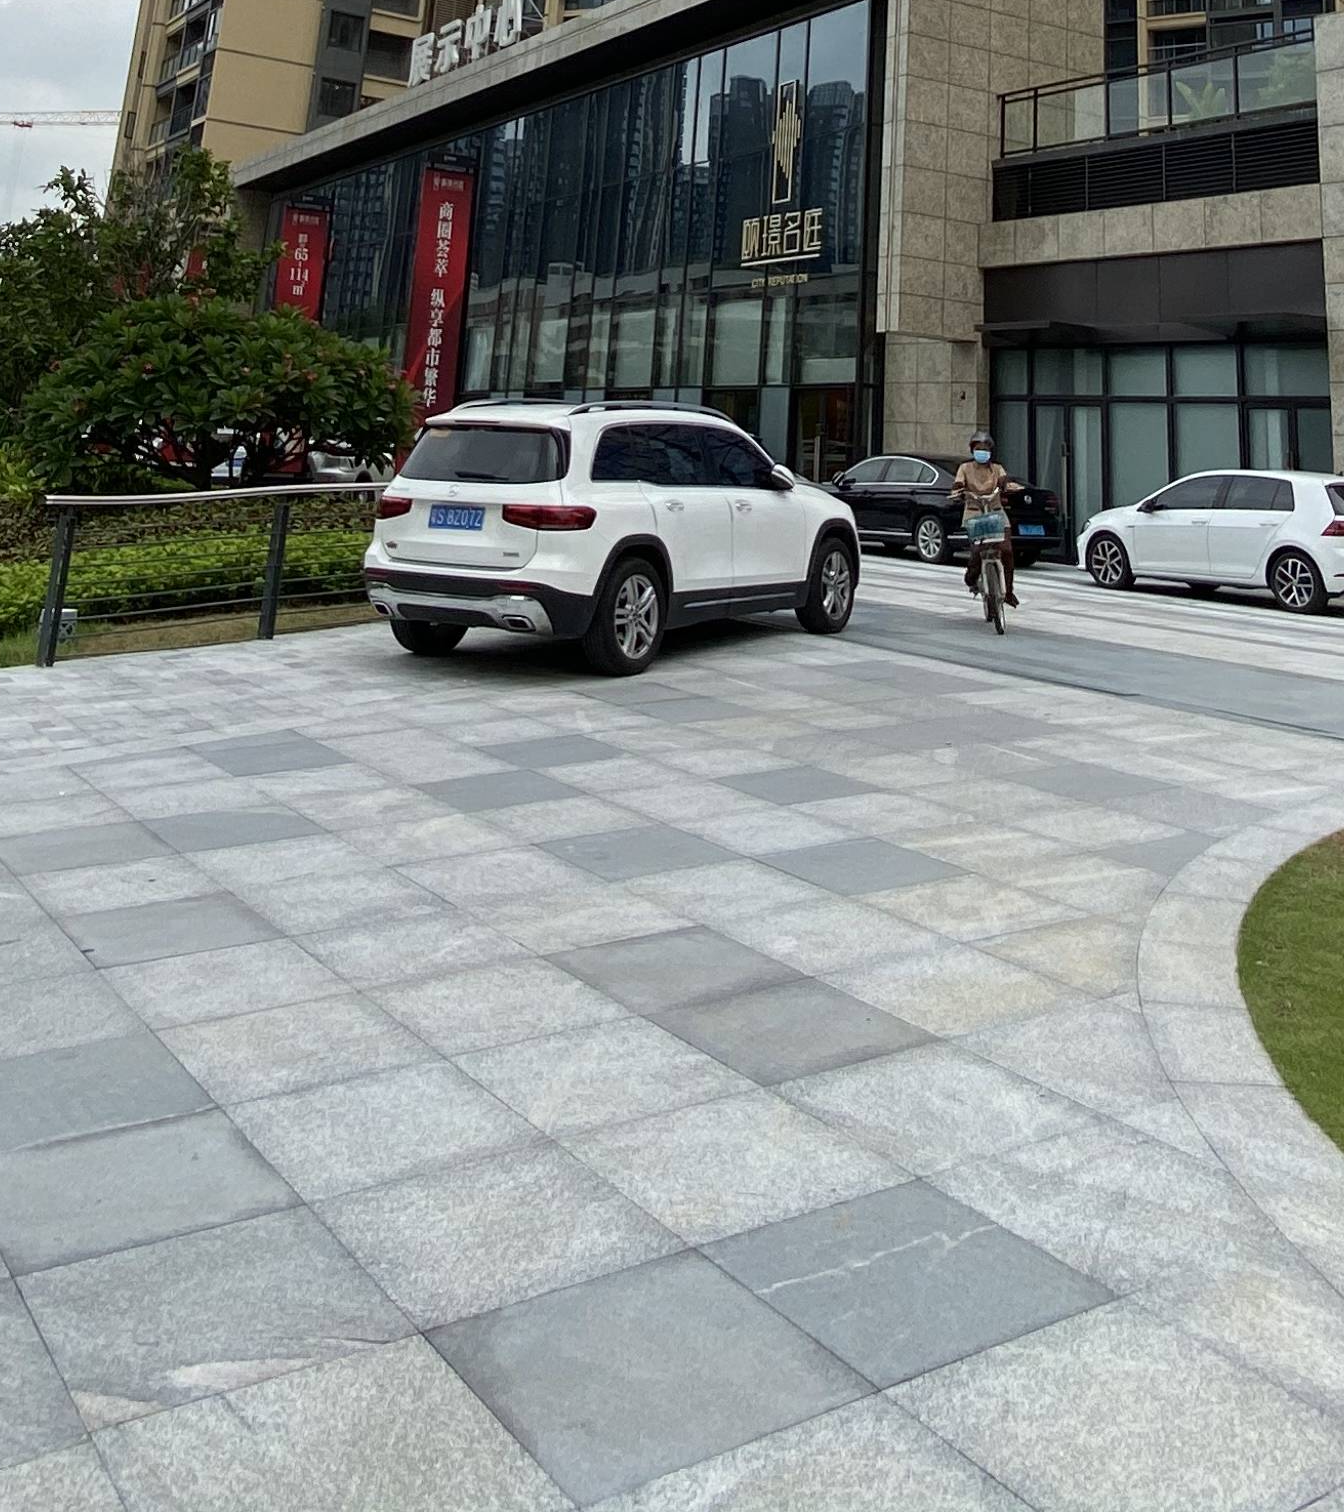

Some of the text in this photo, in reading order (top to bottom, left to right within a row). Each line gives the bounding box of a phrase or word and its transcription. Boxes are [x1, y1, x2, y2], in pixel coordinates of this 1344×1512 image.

[422, 288, 446, 408] 纵享都市繁华
